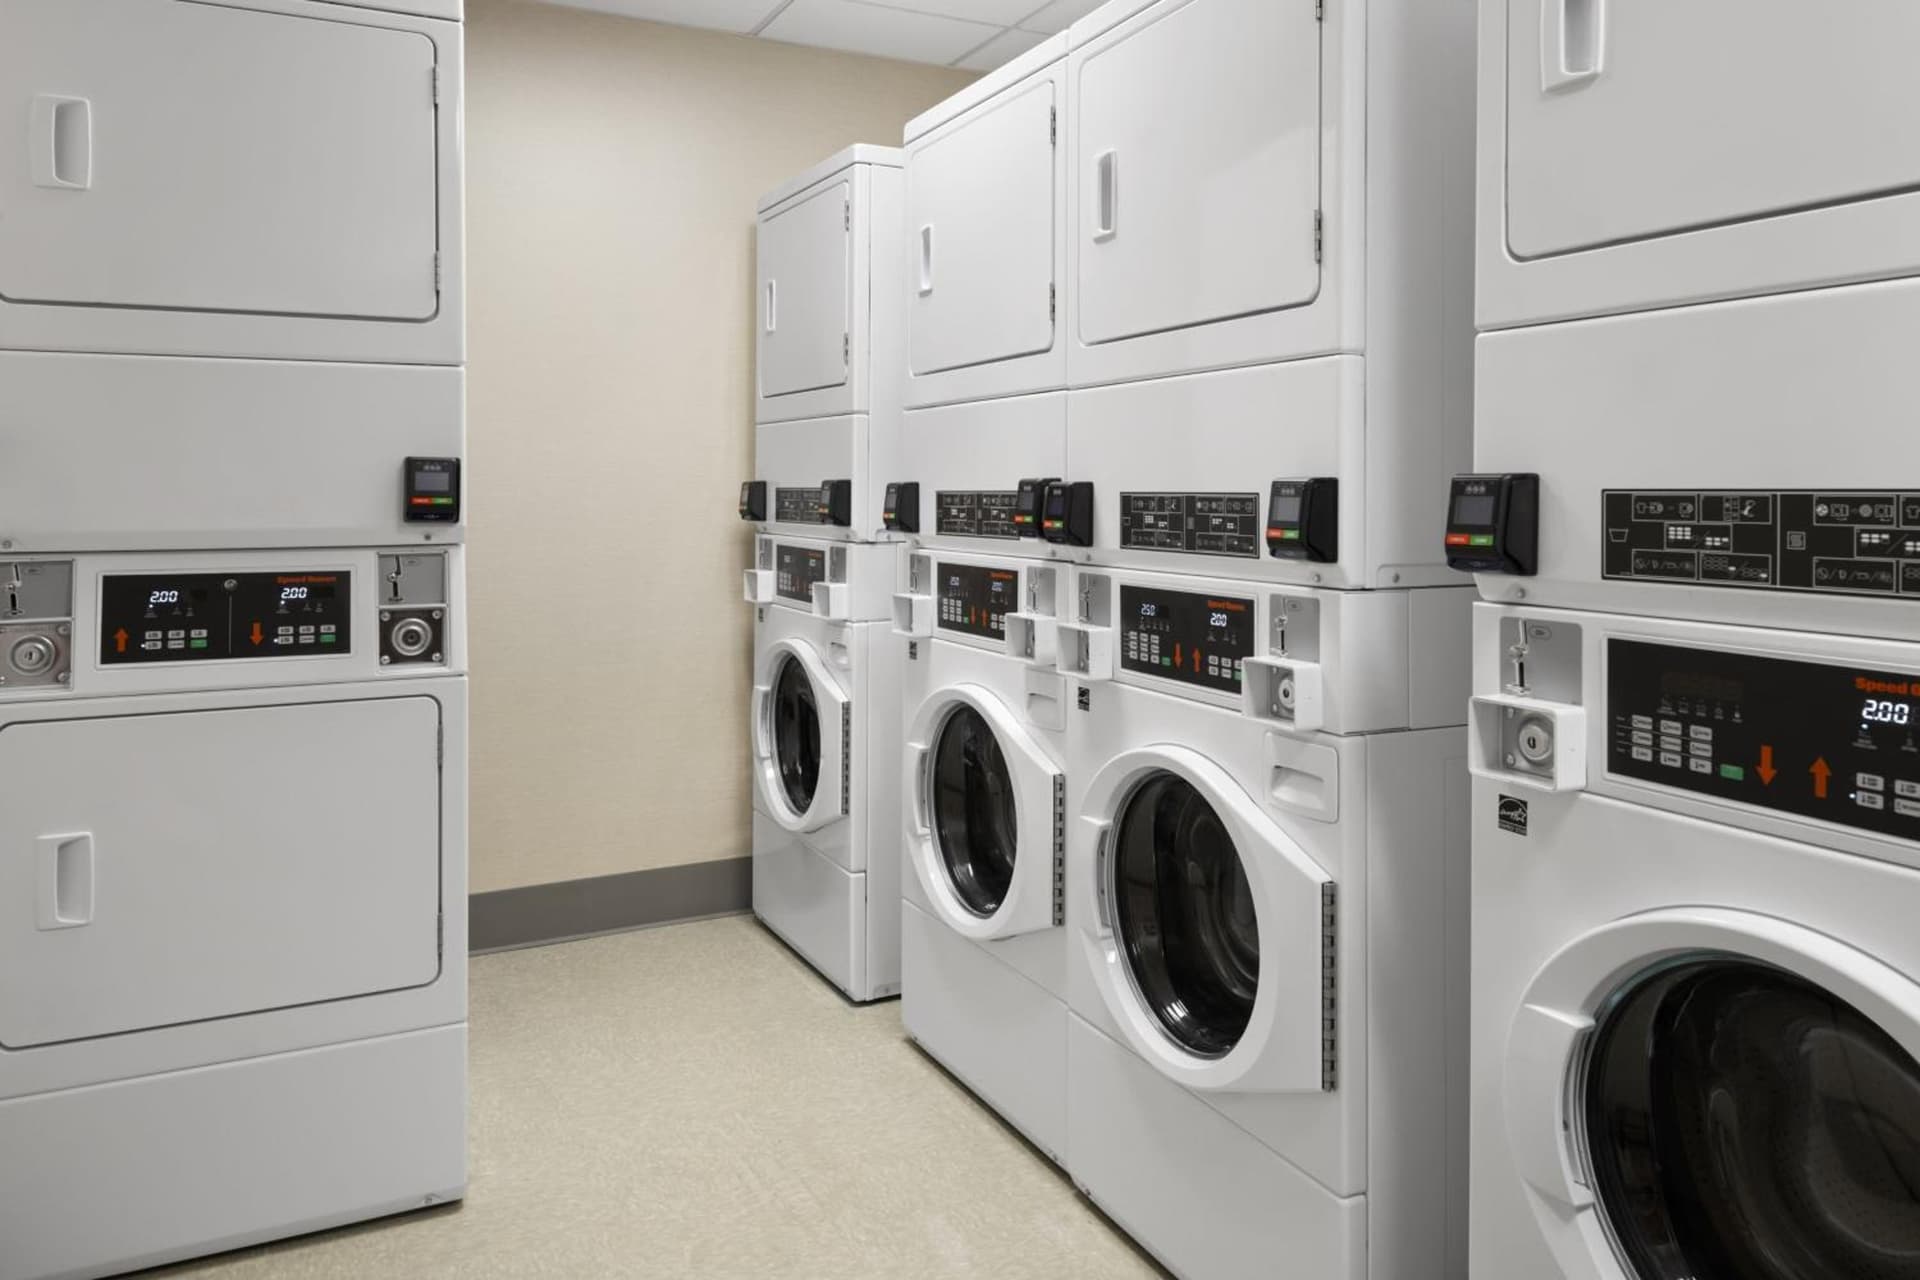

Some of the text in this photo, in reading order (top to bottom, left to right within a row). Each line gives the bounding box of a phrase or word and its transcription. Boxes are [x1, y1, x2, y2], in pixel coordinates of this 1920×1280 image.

[150, 590, 178, 603] 2.00
[281, 587, 308, 599] 2.00
[1855, 676, 1908, 695] Speed
[1861, 699, 1909, 725] 2.00
